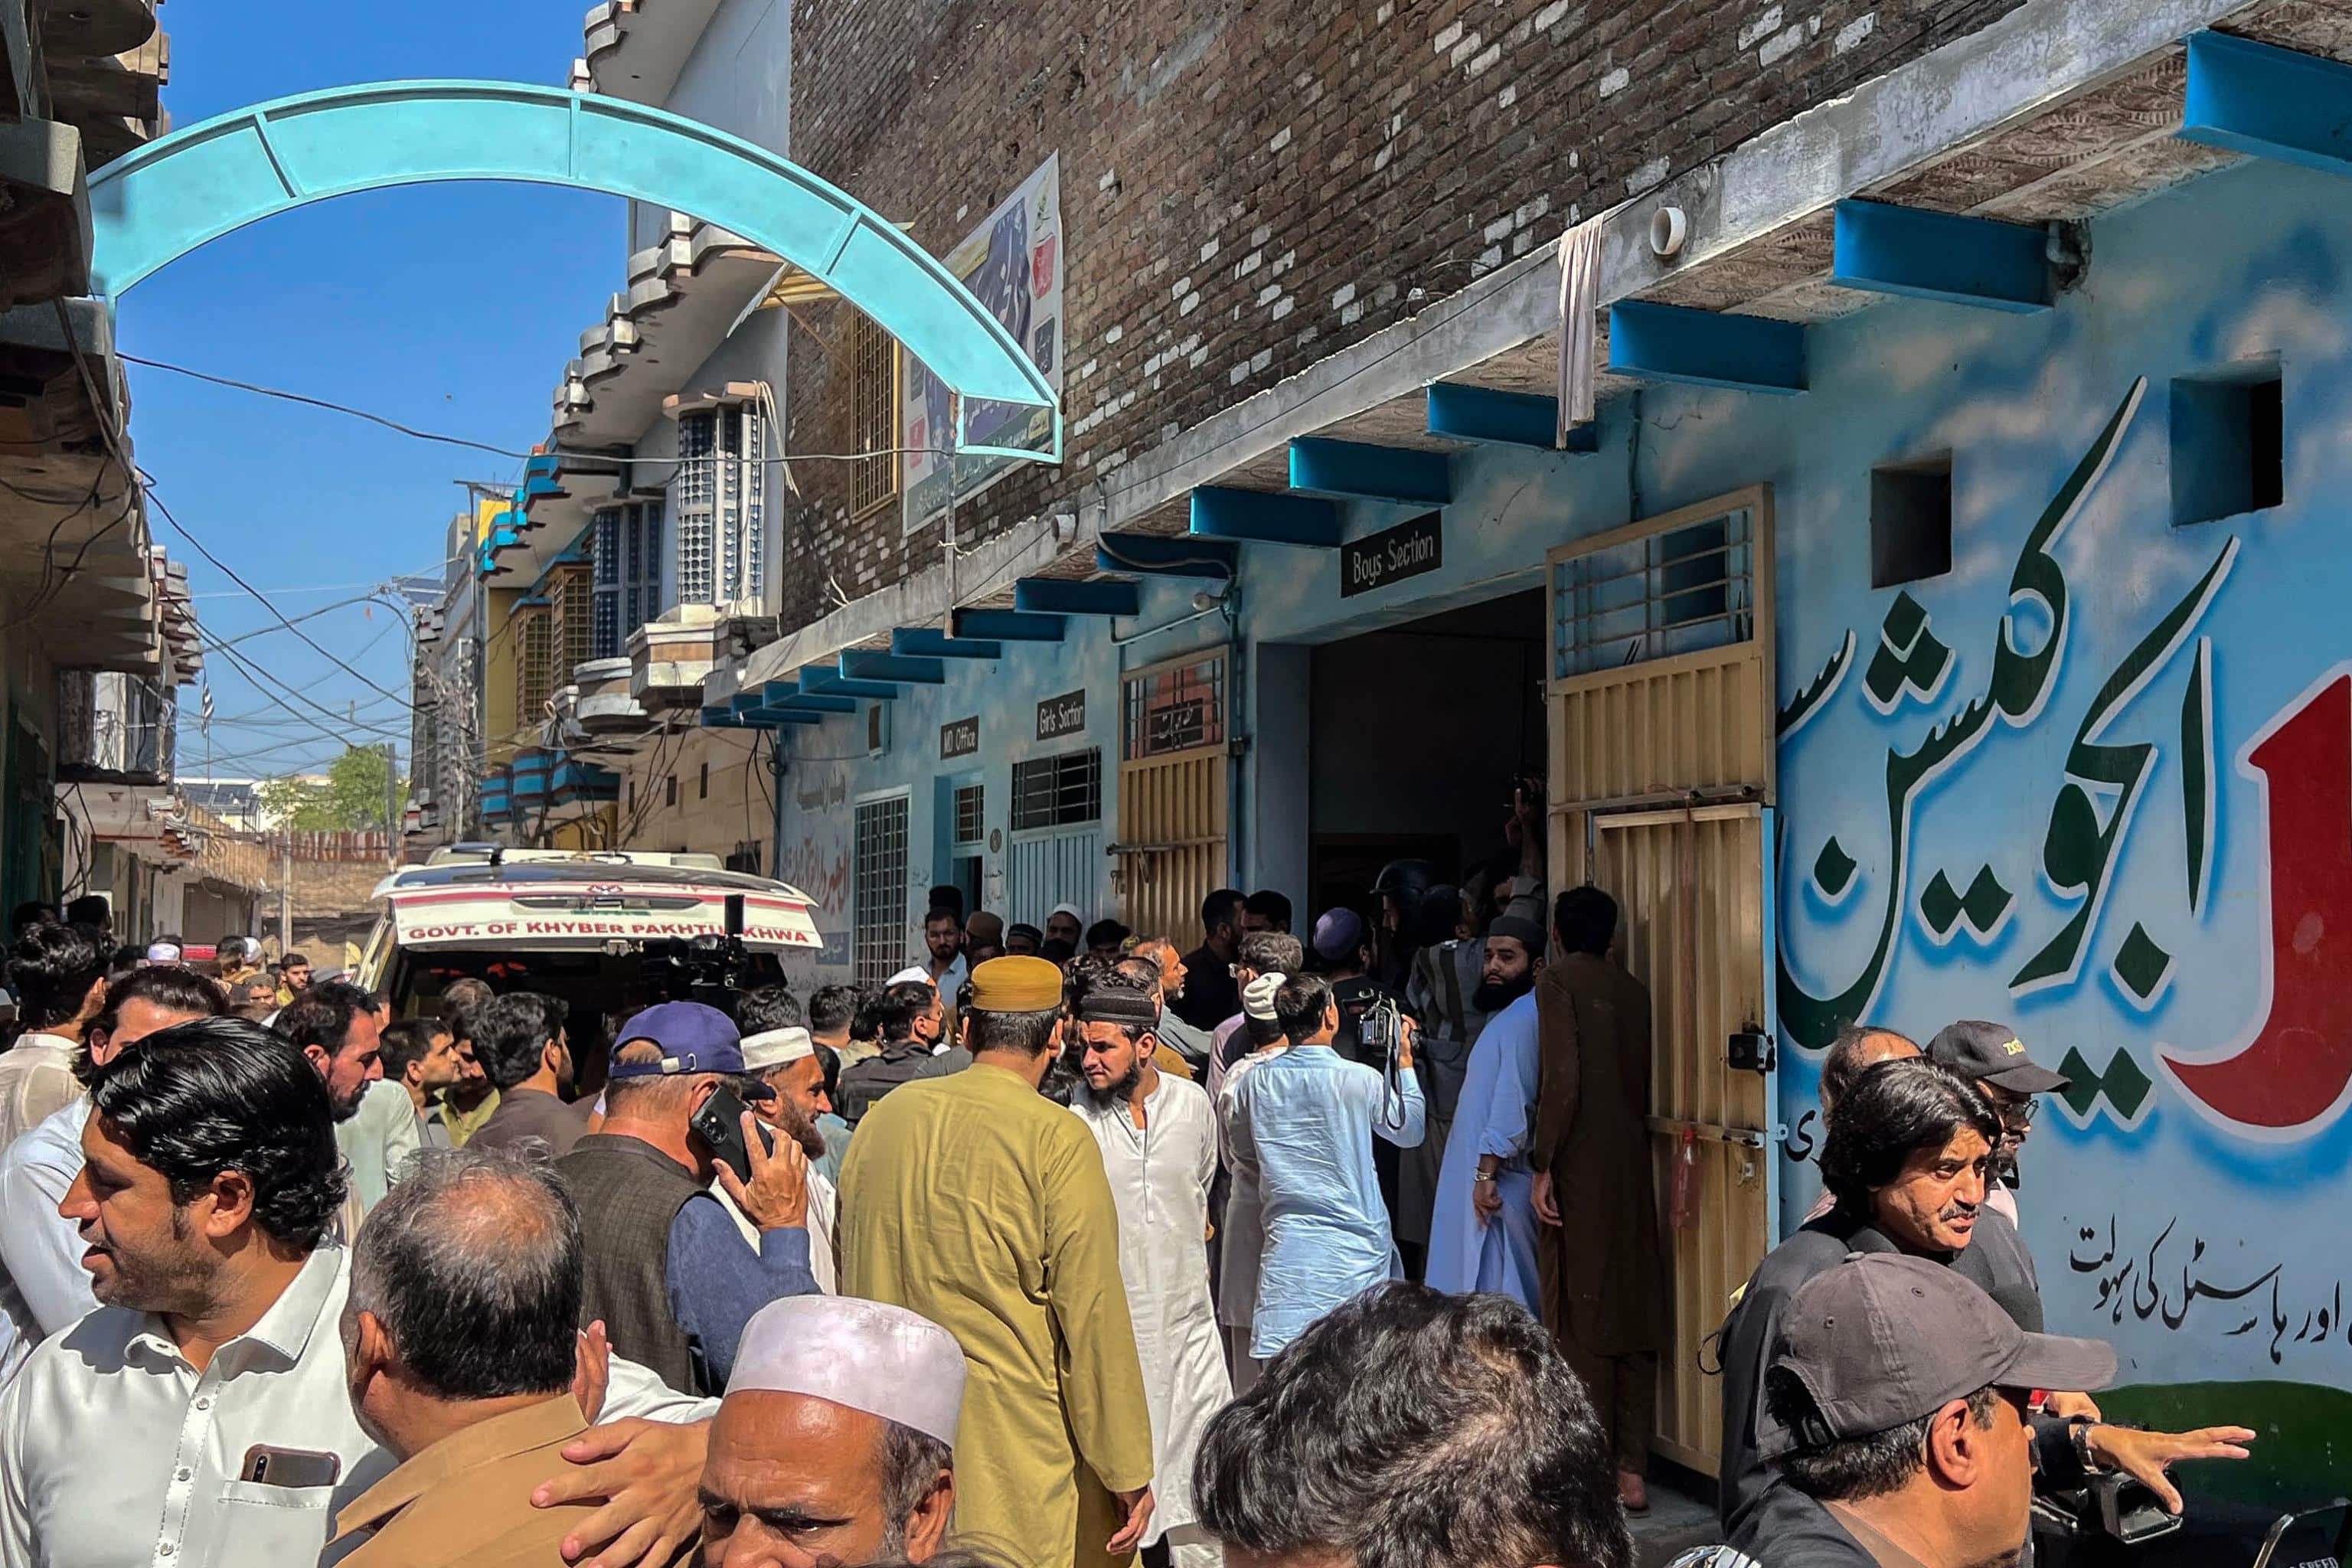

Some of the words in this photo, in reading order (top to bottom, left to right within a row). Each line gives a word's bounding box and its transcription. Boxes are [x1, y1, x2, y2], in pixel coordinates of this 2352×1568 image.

[1353, 551, 1382, 586] Boys
[1388, 531, 1434, 571] Section
[943, 731, 953, 754] MD
[955, 726, 975, 751] Office
[1058, 700, 1084, 730] Section
[409, 926, 480, 939] GOVT.
[487, 923, 518, 934] OF
[527, 921, 625, 934] KHYBER
[632, 923, 808, 942] PAKHTUKHWA
[2069, 1213, 2134, 1325] سہولت
[2133, 1216, 2177, 1321] کی
[2293, 1279, 2341, 1343] اور
